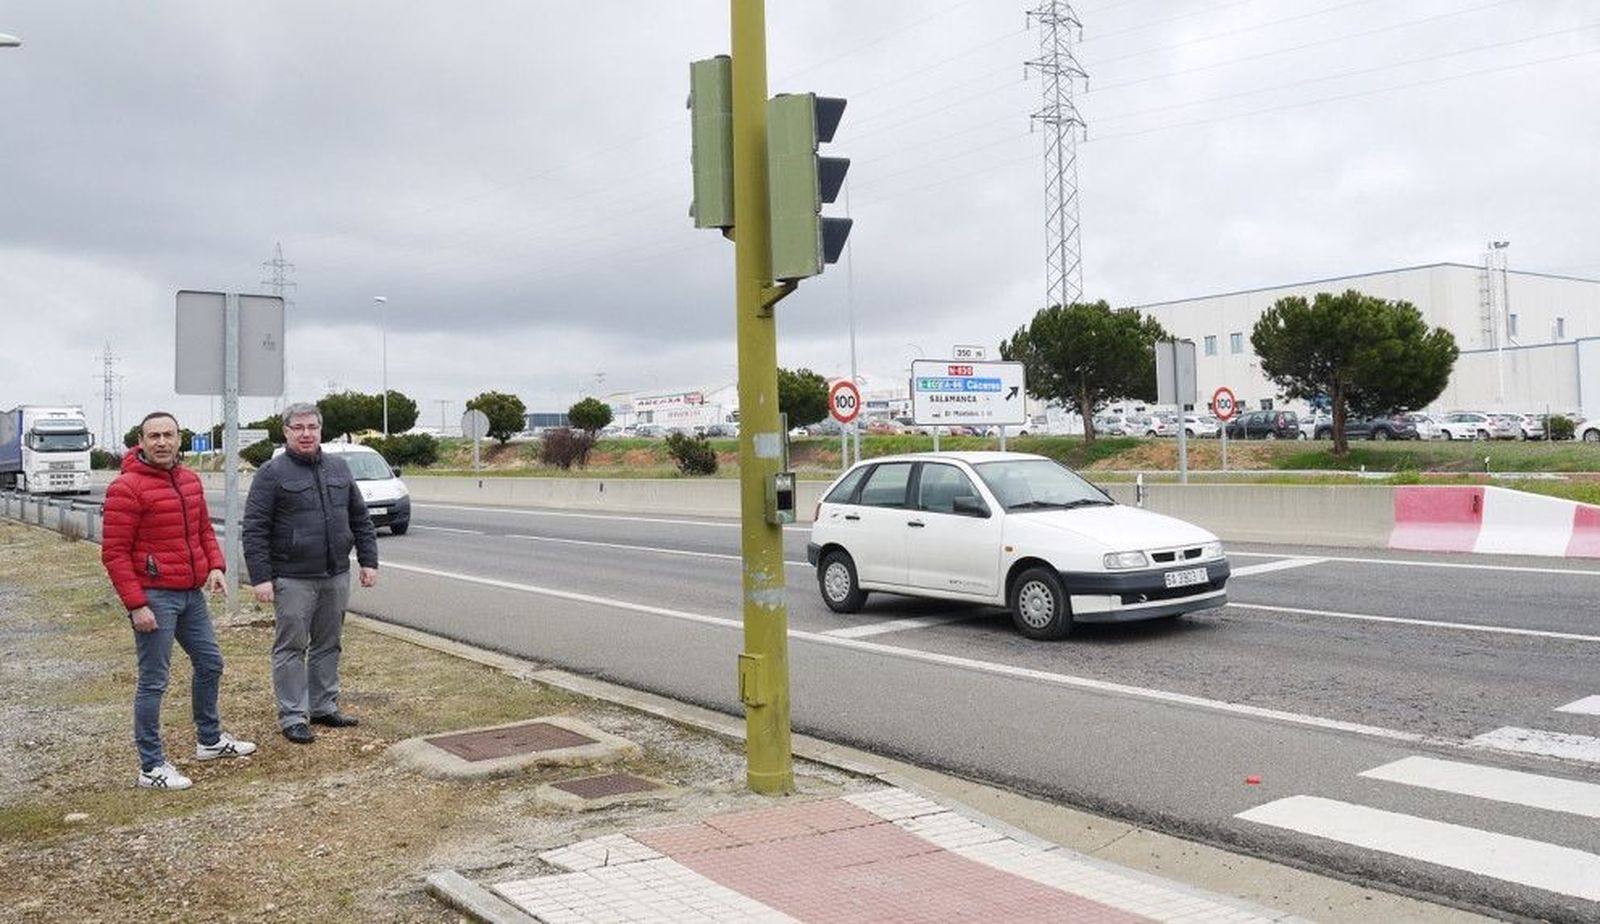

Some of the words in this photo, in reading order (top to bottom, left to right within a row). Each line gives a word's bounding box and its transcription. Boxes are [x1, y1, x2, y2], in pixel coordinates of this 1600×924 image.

[957, 349, 972, 357] 350
[835, 395, 855, 408] 100
[929, 395, 977, 403] SALAMANCA
[1217, 398, 1231, 409] 100
